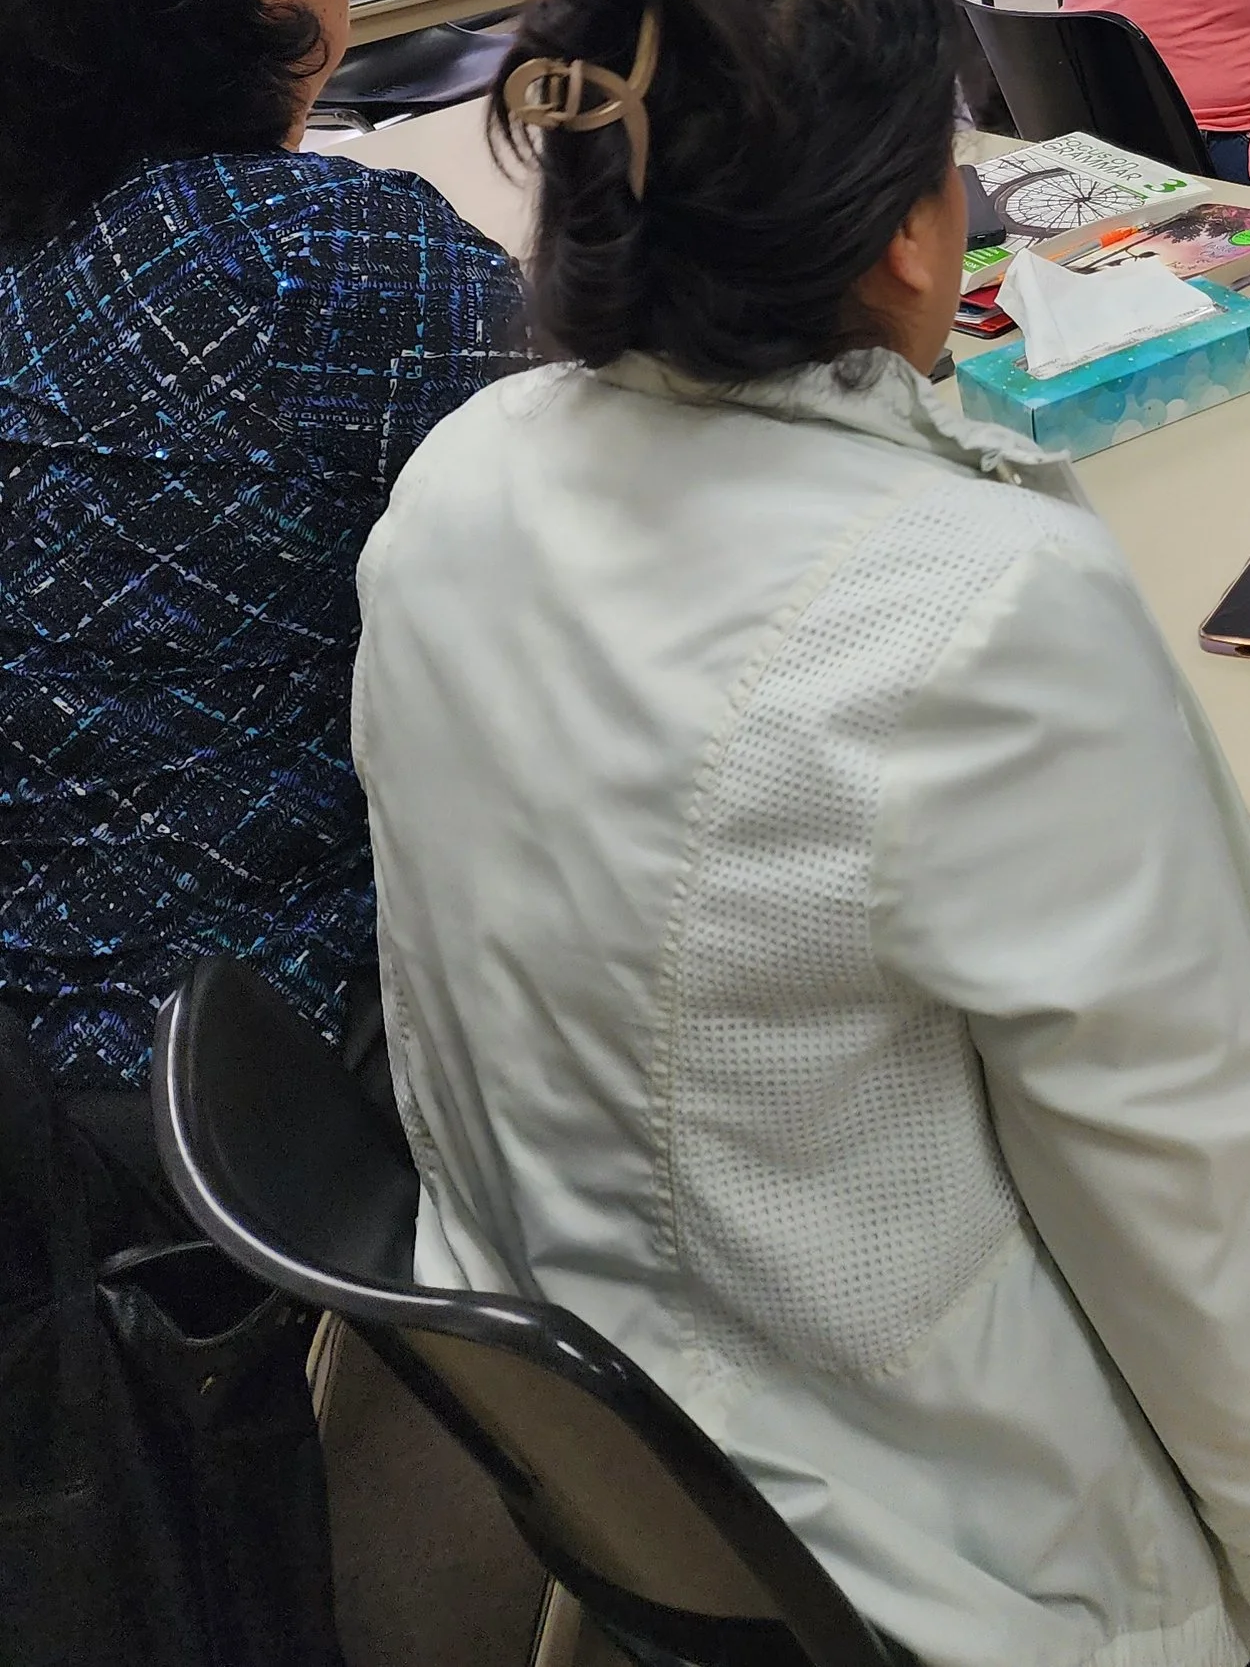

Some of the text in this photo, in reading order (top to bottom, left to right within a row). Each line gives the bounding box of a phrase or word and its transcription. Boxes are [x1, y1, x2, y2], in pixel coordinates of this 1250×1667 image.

[1059, 136, 1112, 159] FOCUS
[1042, 142, 1142, 181] GRAMMAR
[1144, 178, 1187, 193] 3
